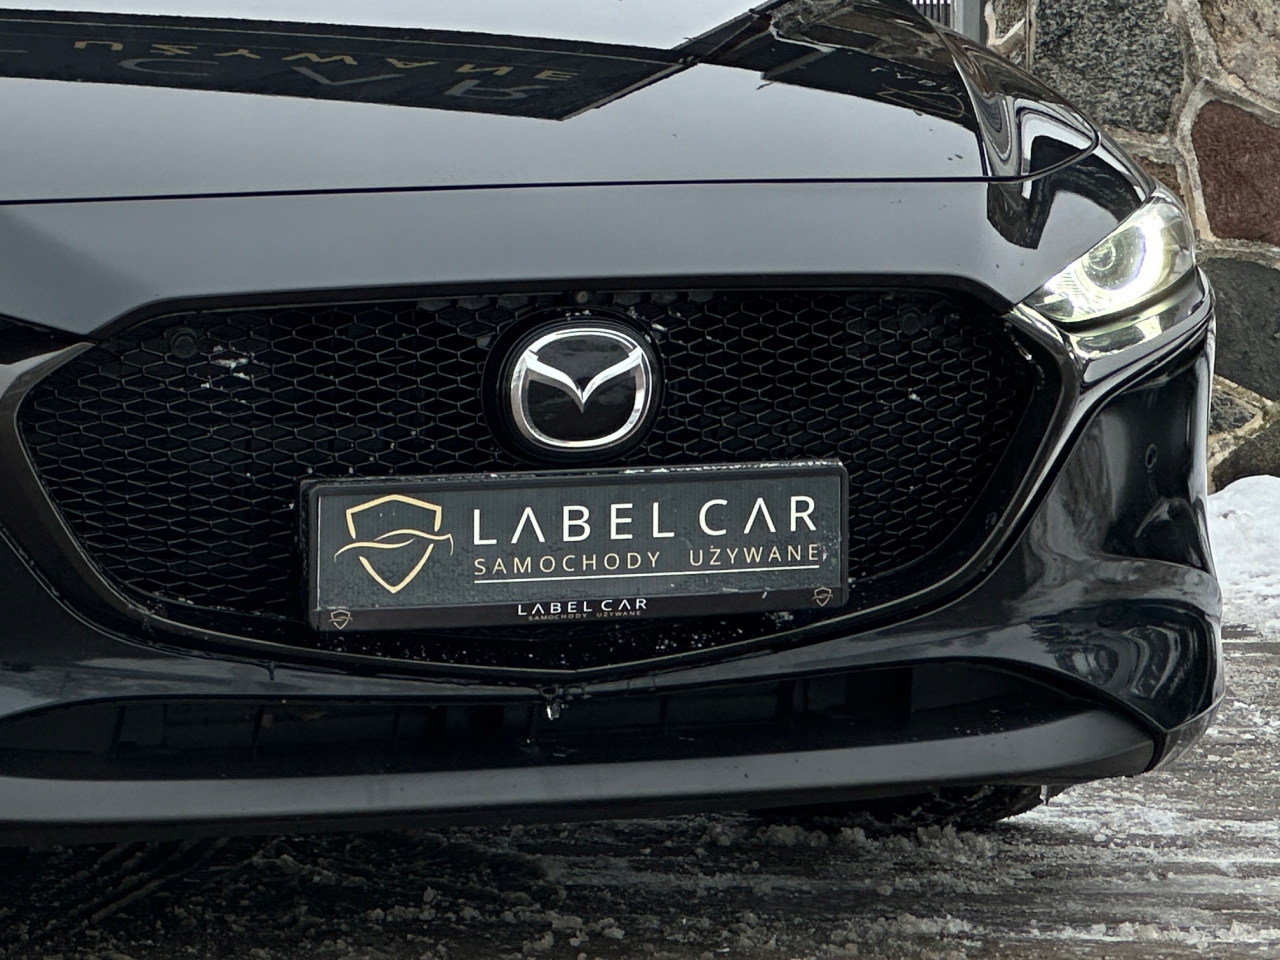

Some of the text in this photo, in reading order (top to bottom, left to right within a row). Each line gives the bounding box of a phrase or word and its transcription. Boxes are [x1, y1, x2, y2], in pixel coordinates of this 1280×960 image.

[473, 495, 817, 546] LABEL CAR
[474, 544, 819, 576] SAMOCHODY UŻYWANE
[518, 598, 647, 616] LABEL CAR
[528, 613, 587, 621] SAMOCHODY
